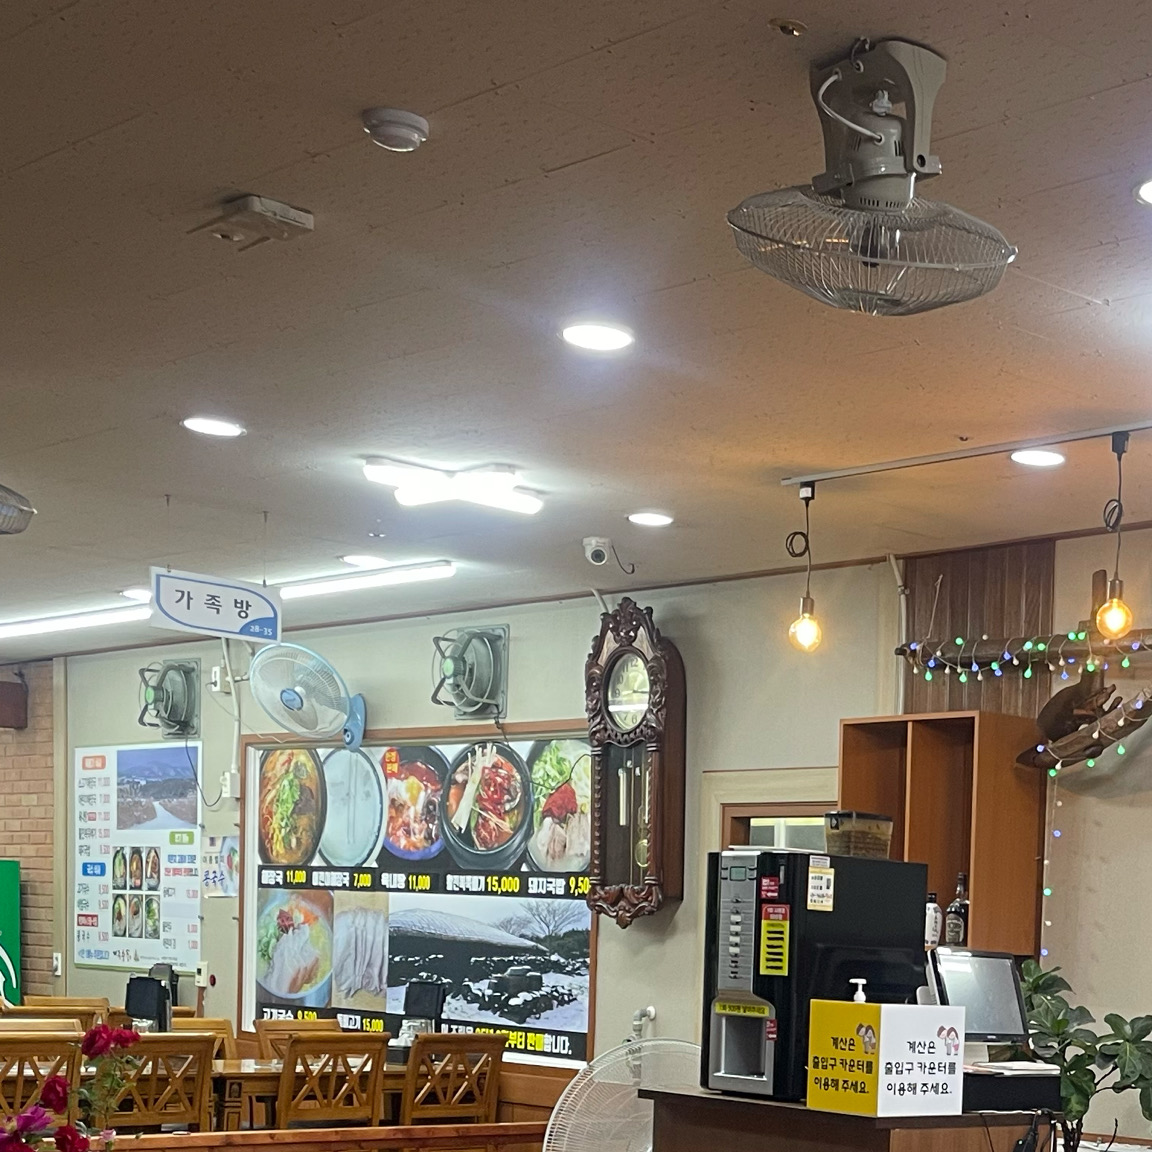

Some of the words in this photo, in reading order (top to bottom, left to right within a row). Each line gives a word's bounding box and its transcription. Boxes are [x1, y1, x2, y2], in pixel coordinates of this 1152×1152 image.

[175, 588, 252, 619] 가족방
[249, 625, 273, 636] 28-35
[286, 870, 306, 884] 11,000
[353, 873, 371, 888] 7,000
[408, 875, 430, 891] 11,000
[486, 876, 520, 894] 15,000
[528, 877, 566, 894] 돼지국밥
[831, 1037, 856, 1051] 계산은
[907, 1041, 936, 1054] 계산은
[813, 1056, 837, 1070] 출입구
[839, 1058, 873, 1074] 카운터를
[885, 1061, 914, 1075] 출입구
[917, 1061, 956, 1075] 카운터를
[814, 1077, 839, 1091] 이용해
[842, 1080, 869, 1094] 주세요.
[886, 1082, 917, 1096] 이용해
[920, 1082, 952, 1096] 주세요.
